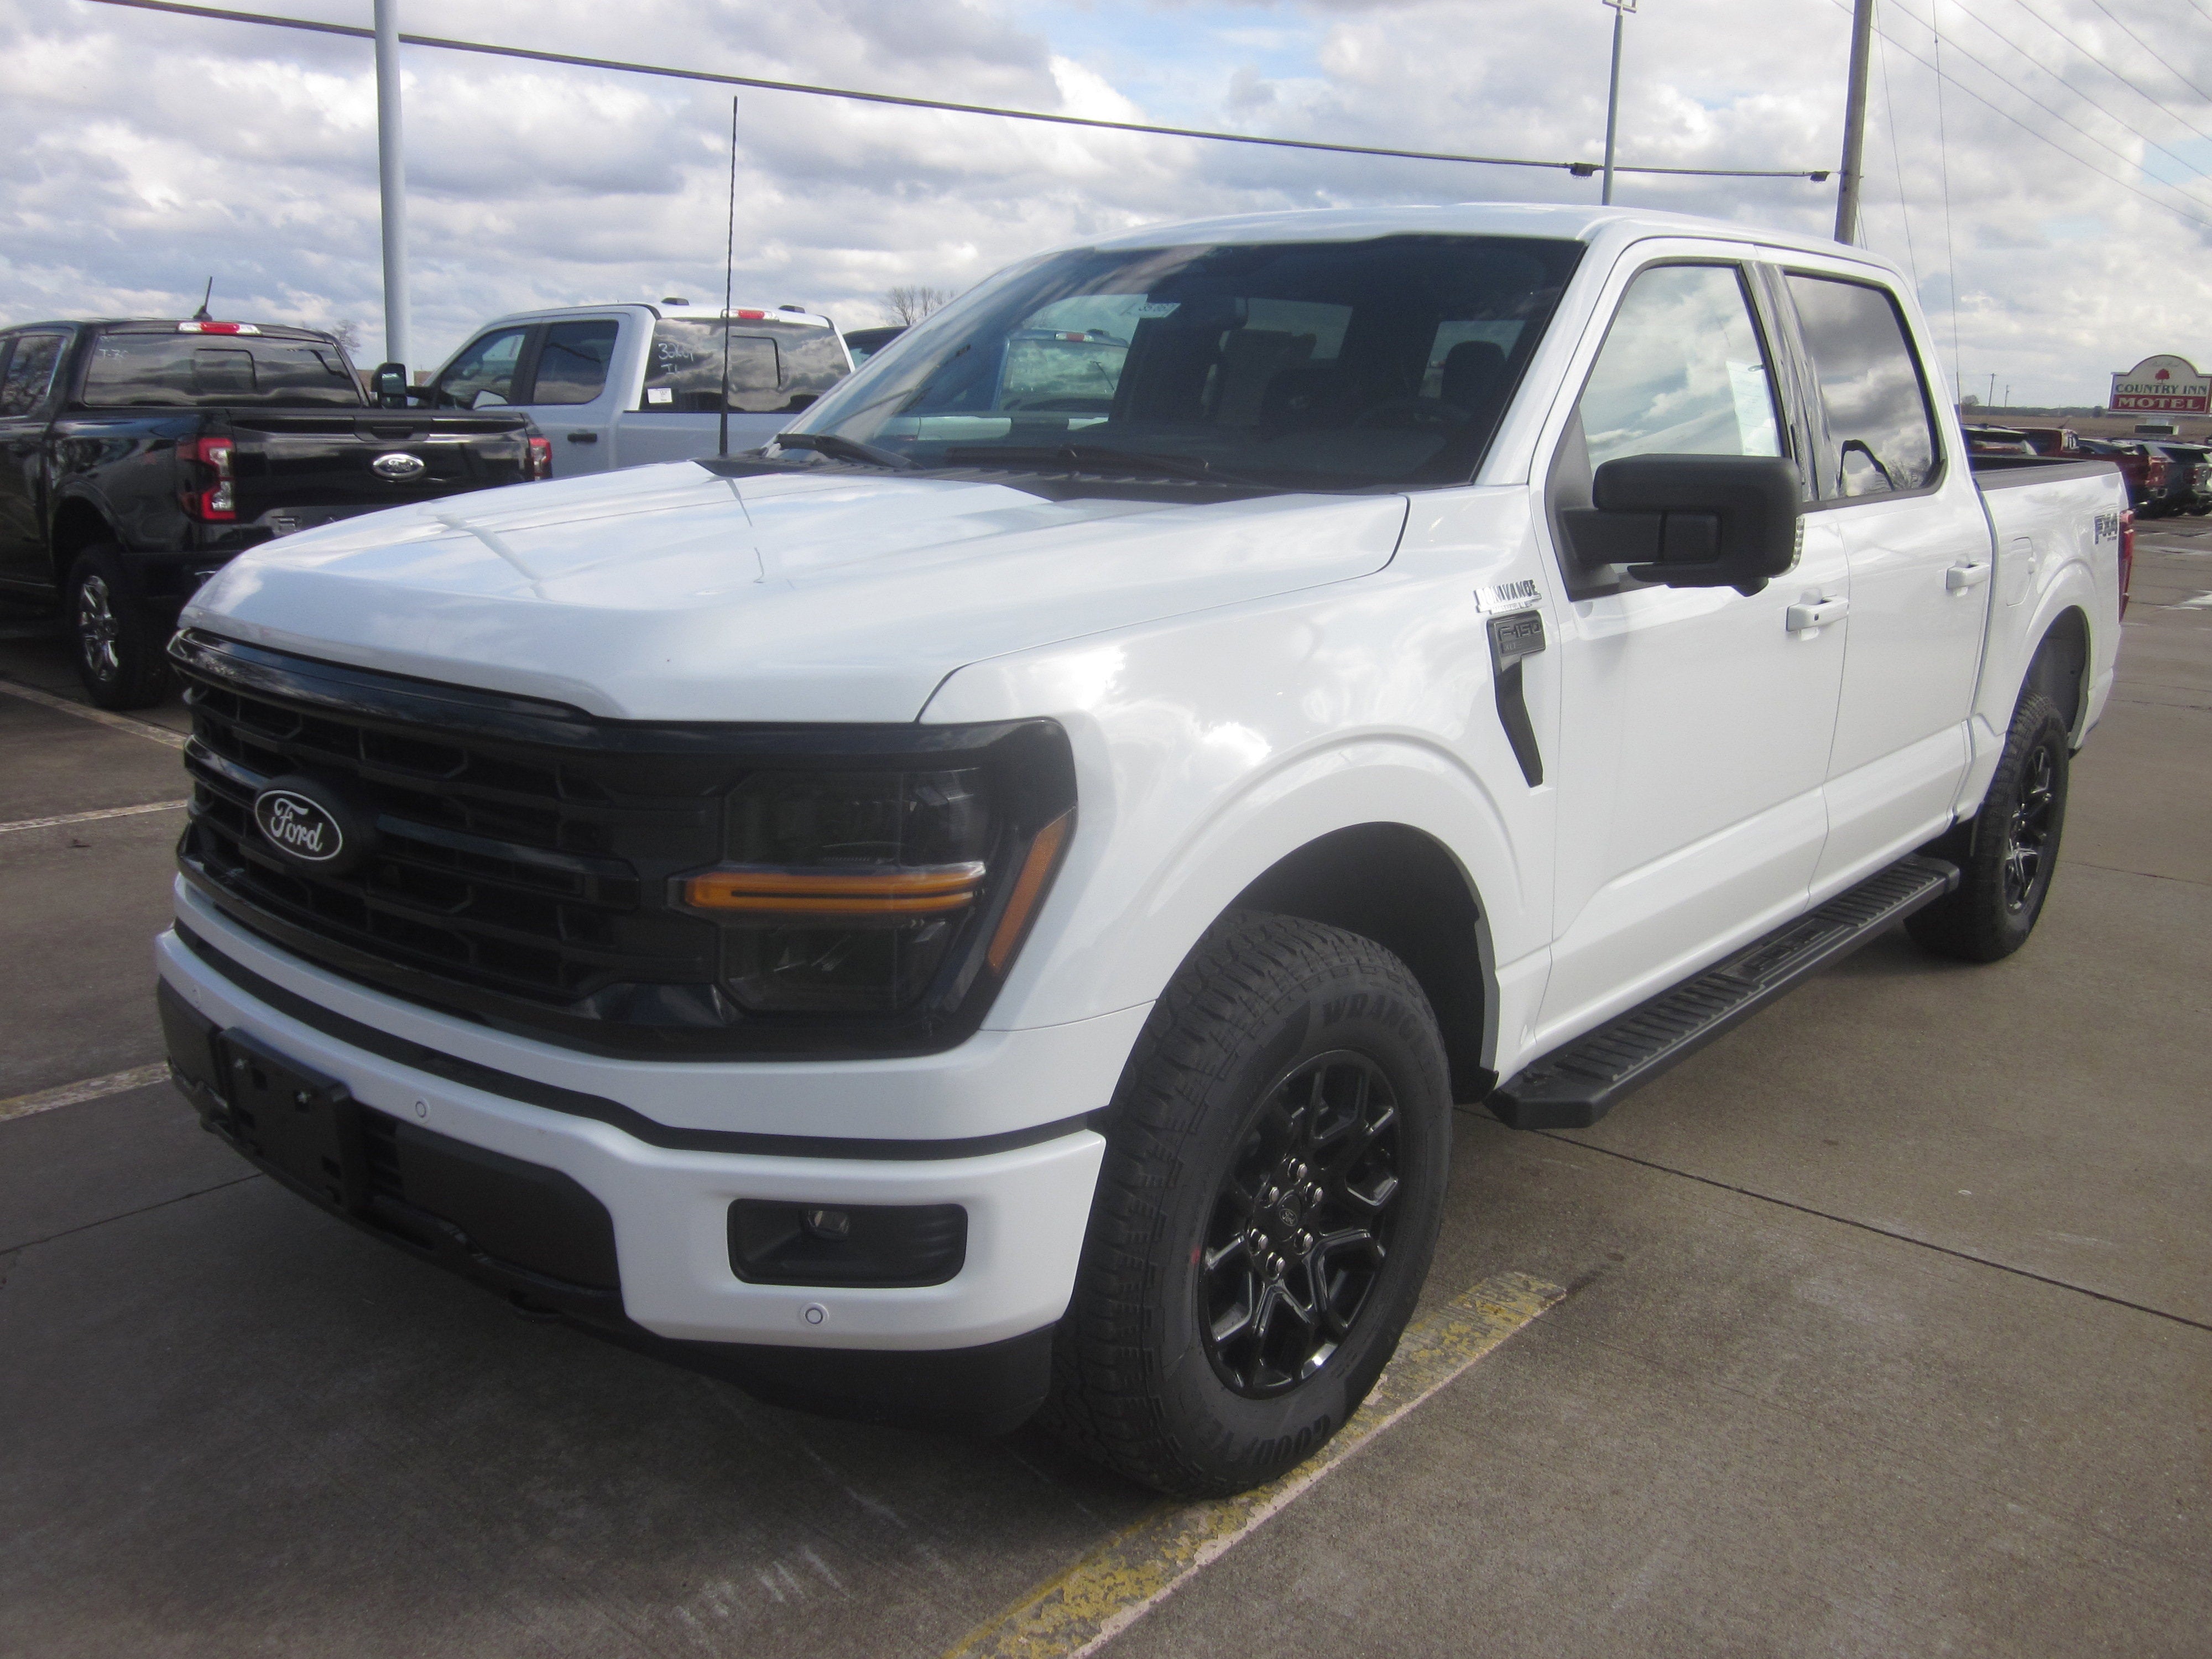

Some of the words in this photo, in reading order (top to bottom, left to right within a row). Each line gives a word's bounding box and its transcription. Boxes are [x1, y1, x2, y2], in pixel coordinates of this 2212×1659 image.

[2116, 384, 2179, 394] COUNTRY
[2183, 385, 2207, 395] INN
[2117, 397, 2200, 409] MOTEL
[1498, 619, 1542, 641] F-150
[270, 797, 323, 852] Ford
